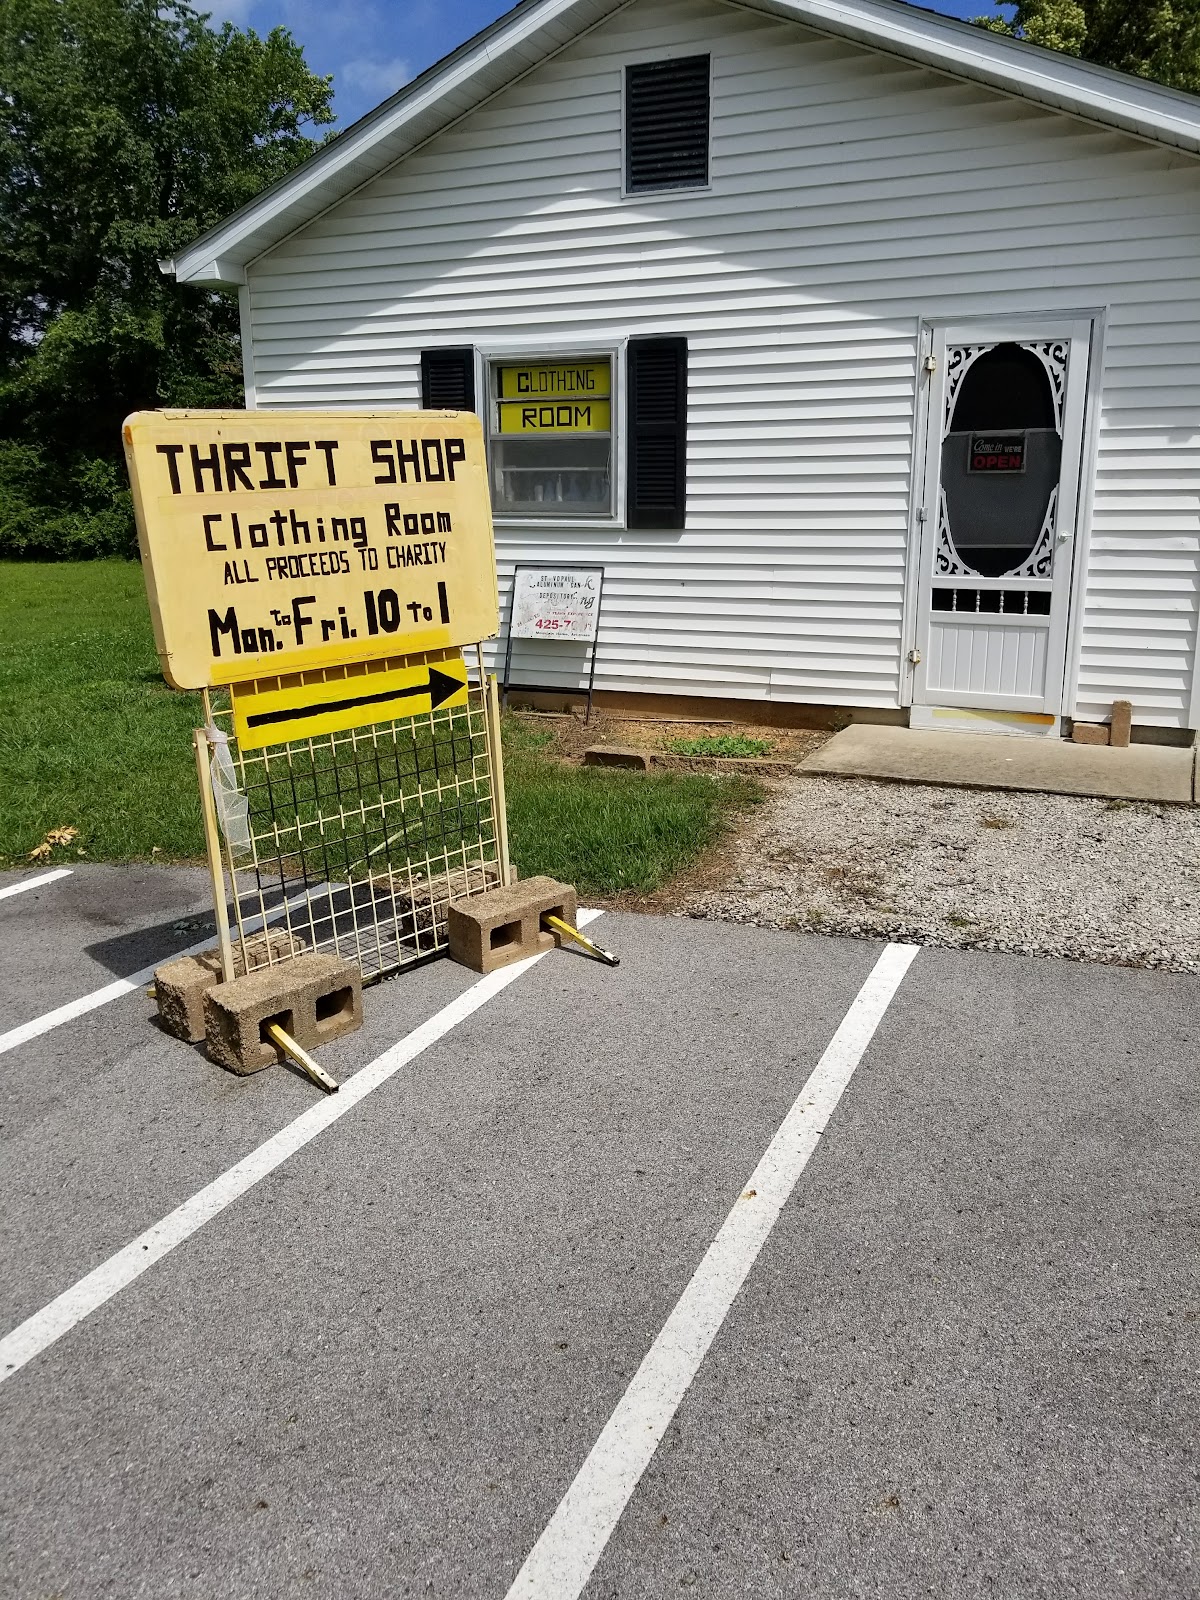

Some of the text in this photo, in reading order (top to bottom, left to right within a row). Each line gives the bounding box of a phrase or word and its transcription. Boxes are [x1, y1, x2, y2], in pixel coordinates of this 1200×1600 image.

[518, 370, 594, 392] CLOTHING
[522, 406, 591, 428] ROOM
[156, 438, 466, 494] THRIFT SHOP
[974, 455, 1021, 468] OPEN
[203, 503, 452, 552] Clothing Room
[224, 541, 447, 585] ALL PROCEEDS TO CHARITY
[207, 581, 451, 657] Mon. to Fri. 10 to 1
